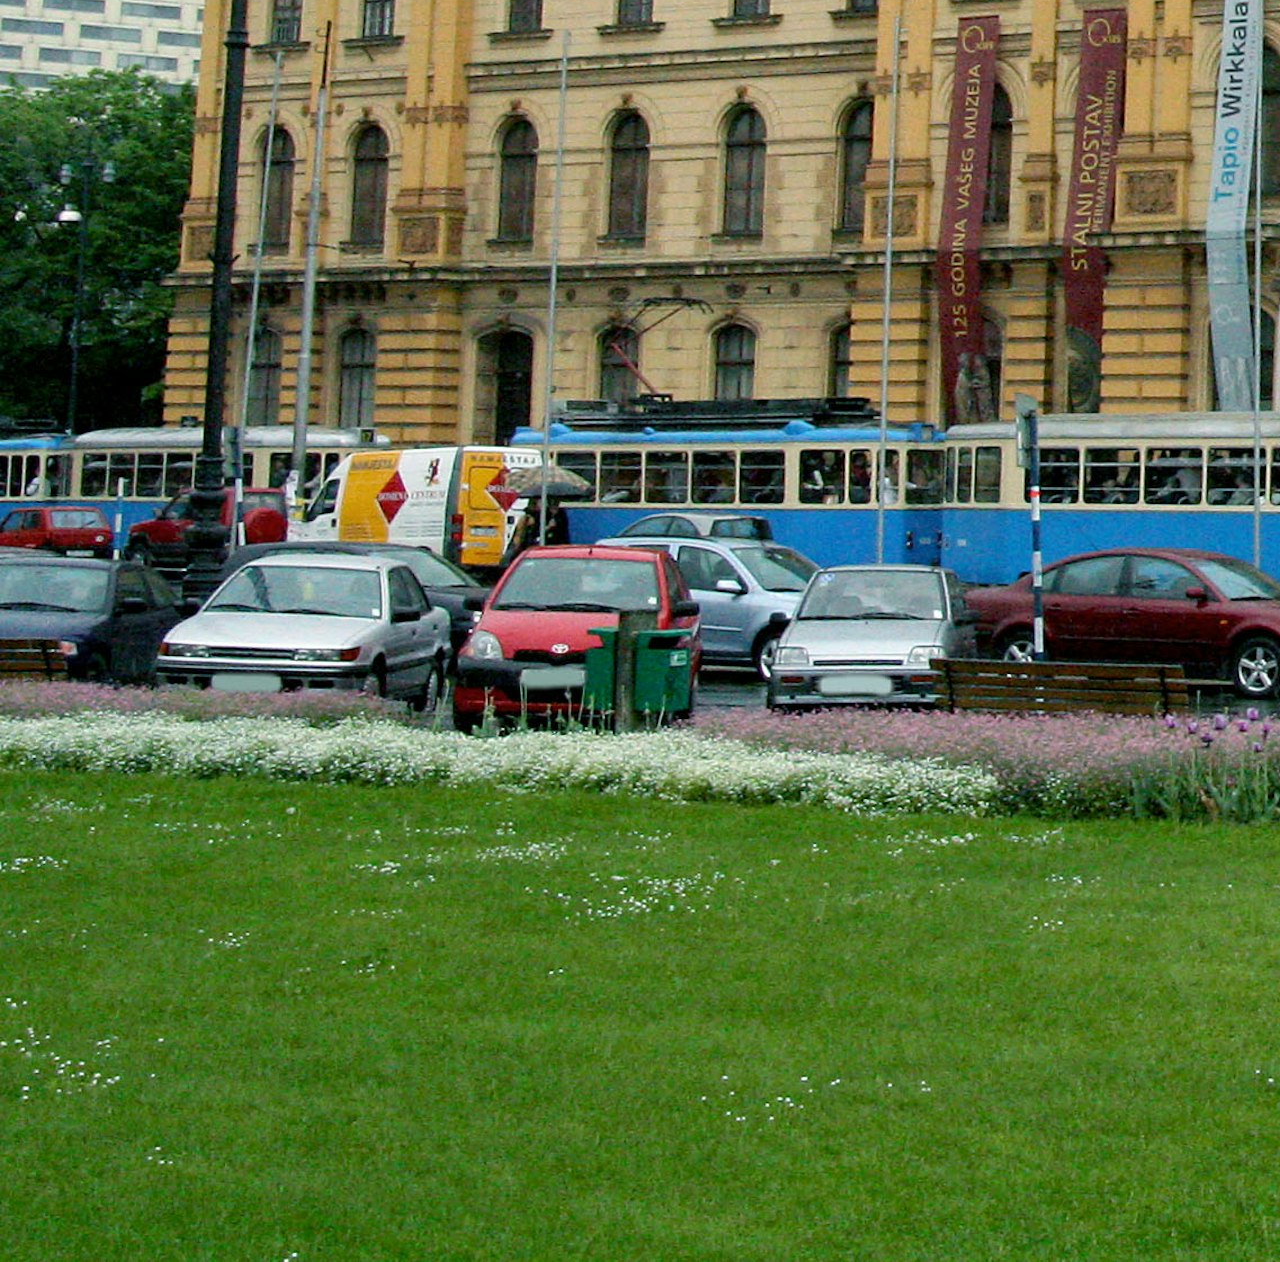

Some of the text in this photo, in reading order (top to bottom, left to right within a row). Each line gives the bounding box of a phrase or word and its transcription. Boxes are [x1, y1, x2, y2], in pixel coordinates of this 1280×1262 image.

[1221, 1, 1250, 118] Wirkkala
[951, 64, 982, 338] 125 GODINA VAŠEG MUZEJA
[1071, 94, 1103, 271] STALNI POSTAV
[1213, 127, 1240, 202] Tapio
